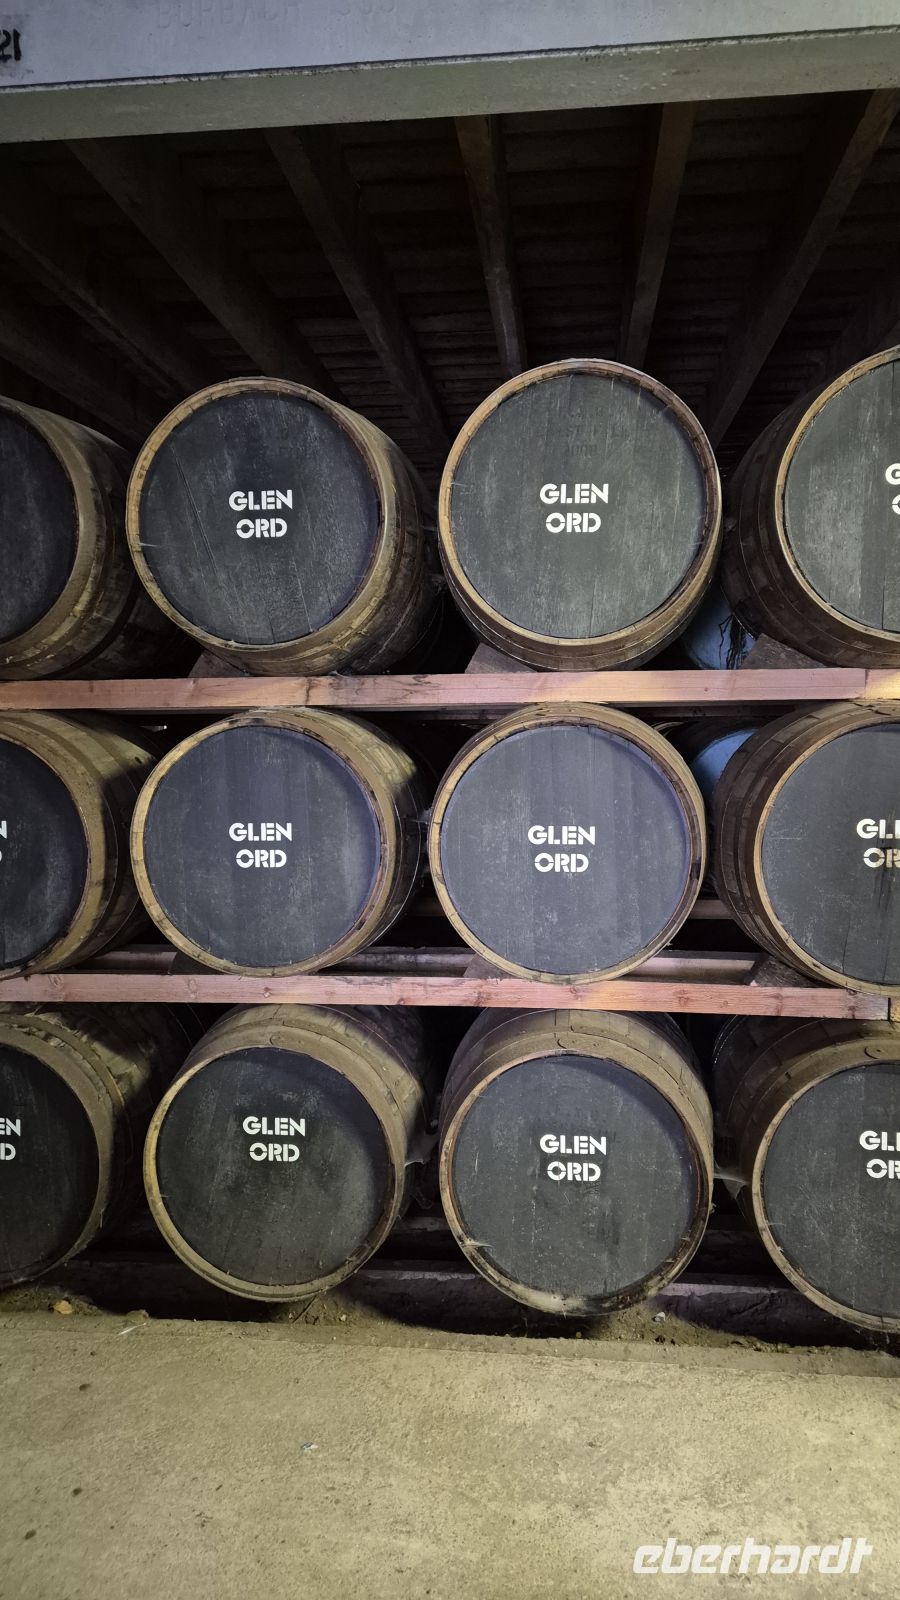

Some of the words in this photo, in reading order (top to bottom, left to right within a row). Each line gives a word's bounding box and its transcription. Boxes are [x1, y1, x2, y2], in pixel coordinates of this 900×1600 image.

[228, 490, 292, 512] GLEN
[539, 483, 609, 505] GLEN
[235, 518, 287, 539] ORD
[545, 512, 601, 534] ORD
[228, 822, 293, 842] GLEN
[527, 825, 596, 846] GLEN
[235, 849, 287, 868] ORD
[533, 852, 590, 873] ORD
[242, 1116, 306, 1137] GLEN
[539, 1134, 607, 1155] GLEN
[859, 1130, 900, 1152] GL
[249, 1143, 300, 1162] ORD
[546, 1161, 602, 1183] ORD
